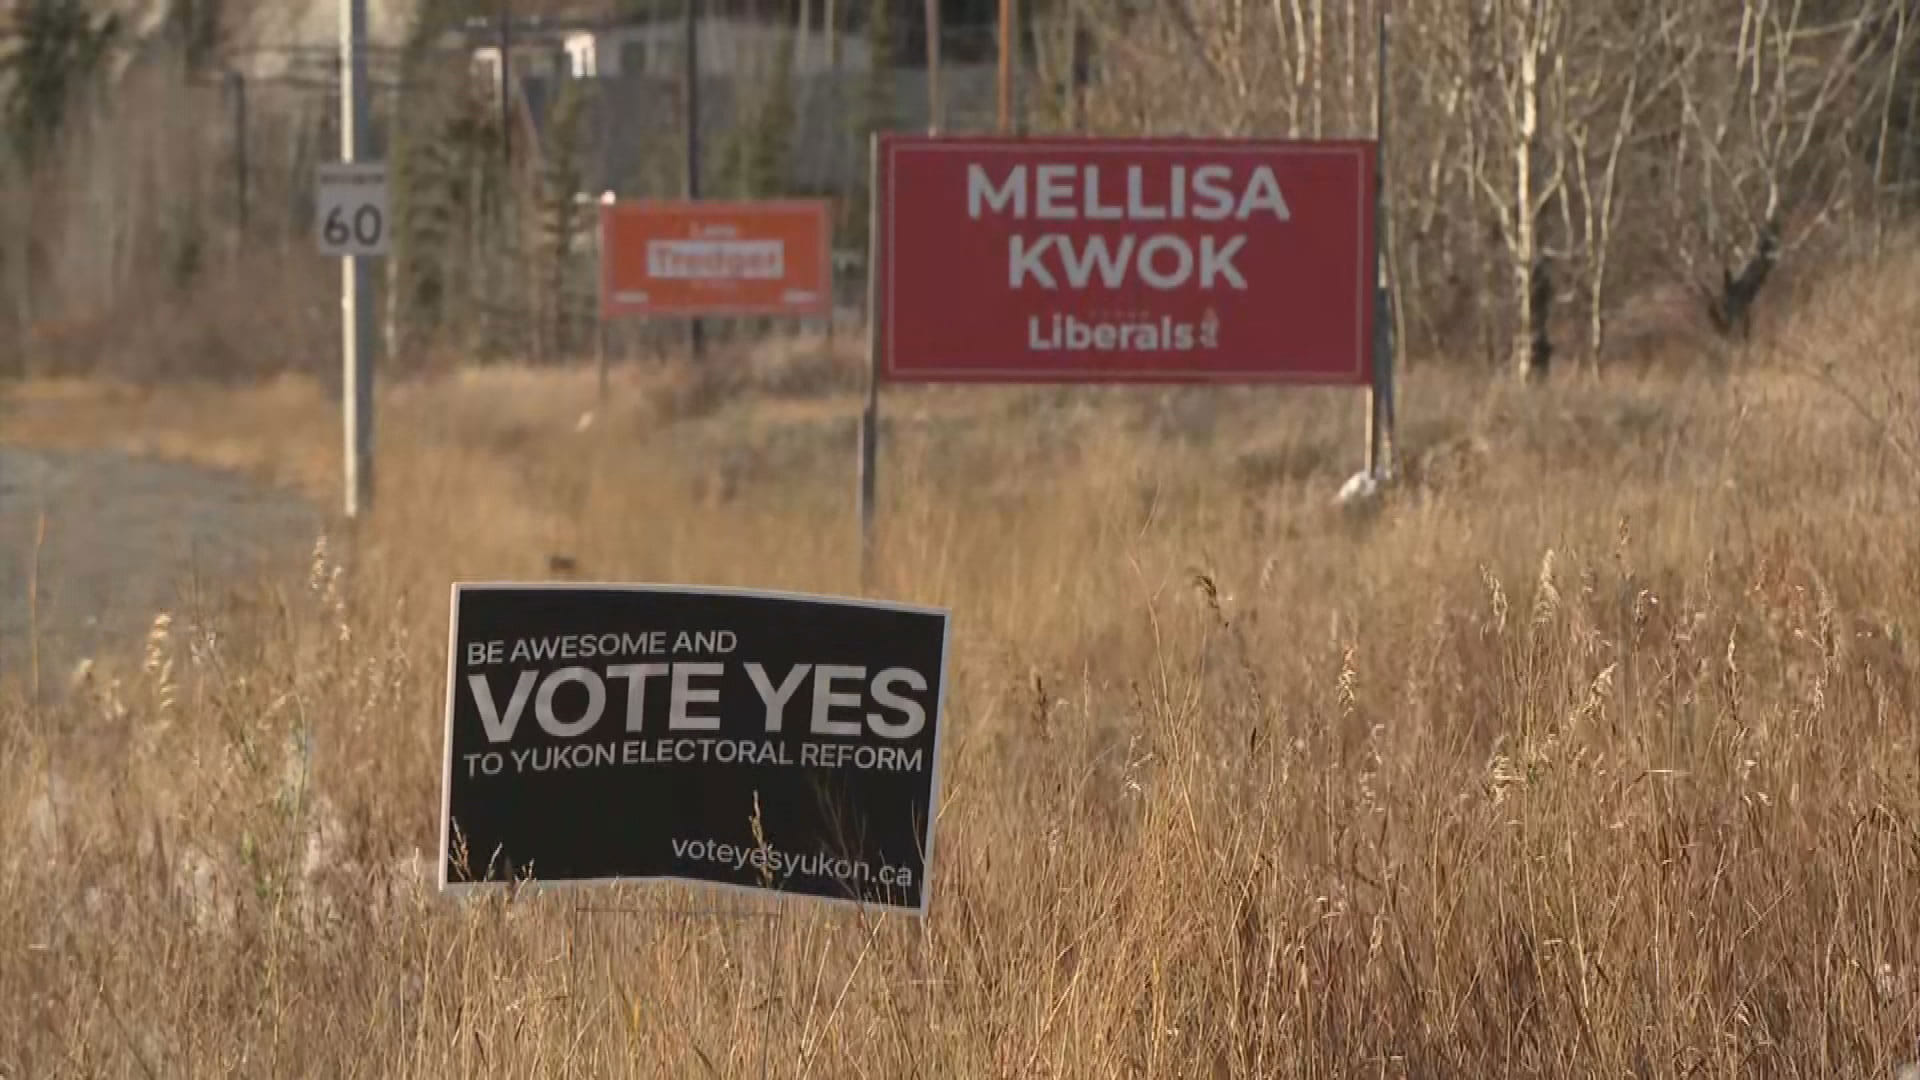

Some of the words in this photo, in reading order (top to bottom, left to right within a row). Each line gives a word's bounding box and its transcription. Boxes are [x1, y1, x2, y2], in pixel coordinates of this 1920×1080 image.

[967, 164, 1290, 221] MELLISA
[324, 203, 382, 246] 60
[1008, 234, 1248, 289] KWOK
[1029, 313, 1194, 350] Liberals
[467, 641, 504, 665] BE
[510, 632, 667, 662] AWESOME
[672, 631, 738, 659] AND
[467, 662, 724, 743] VOTE
[743, 661, 928, 739] YES
[463, 752, 504, 779] TO
[511, 742, 616, 773] YUKON
[622, 739, 794, 764] ELECTORAL
[800, 743, 922, 772] REFORM
[671, 837, 912, 888] voteyesyukon.ca
